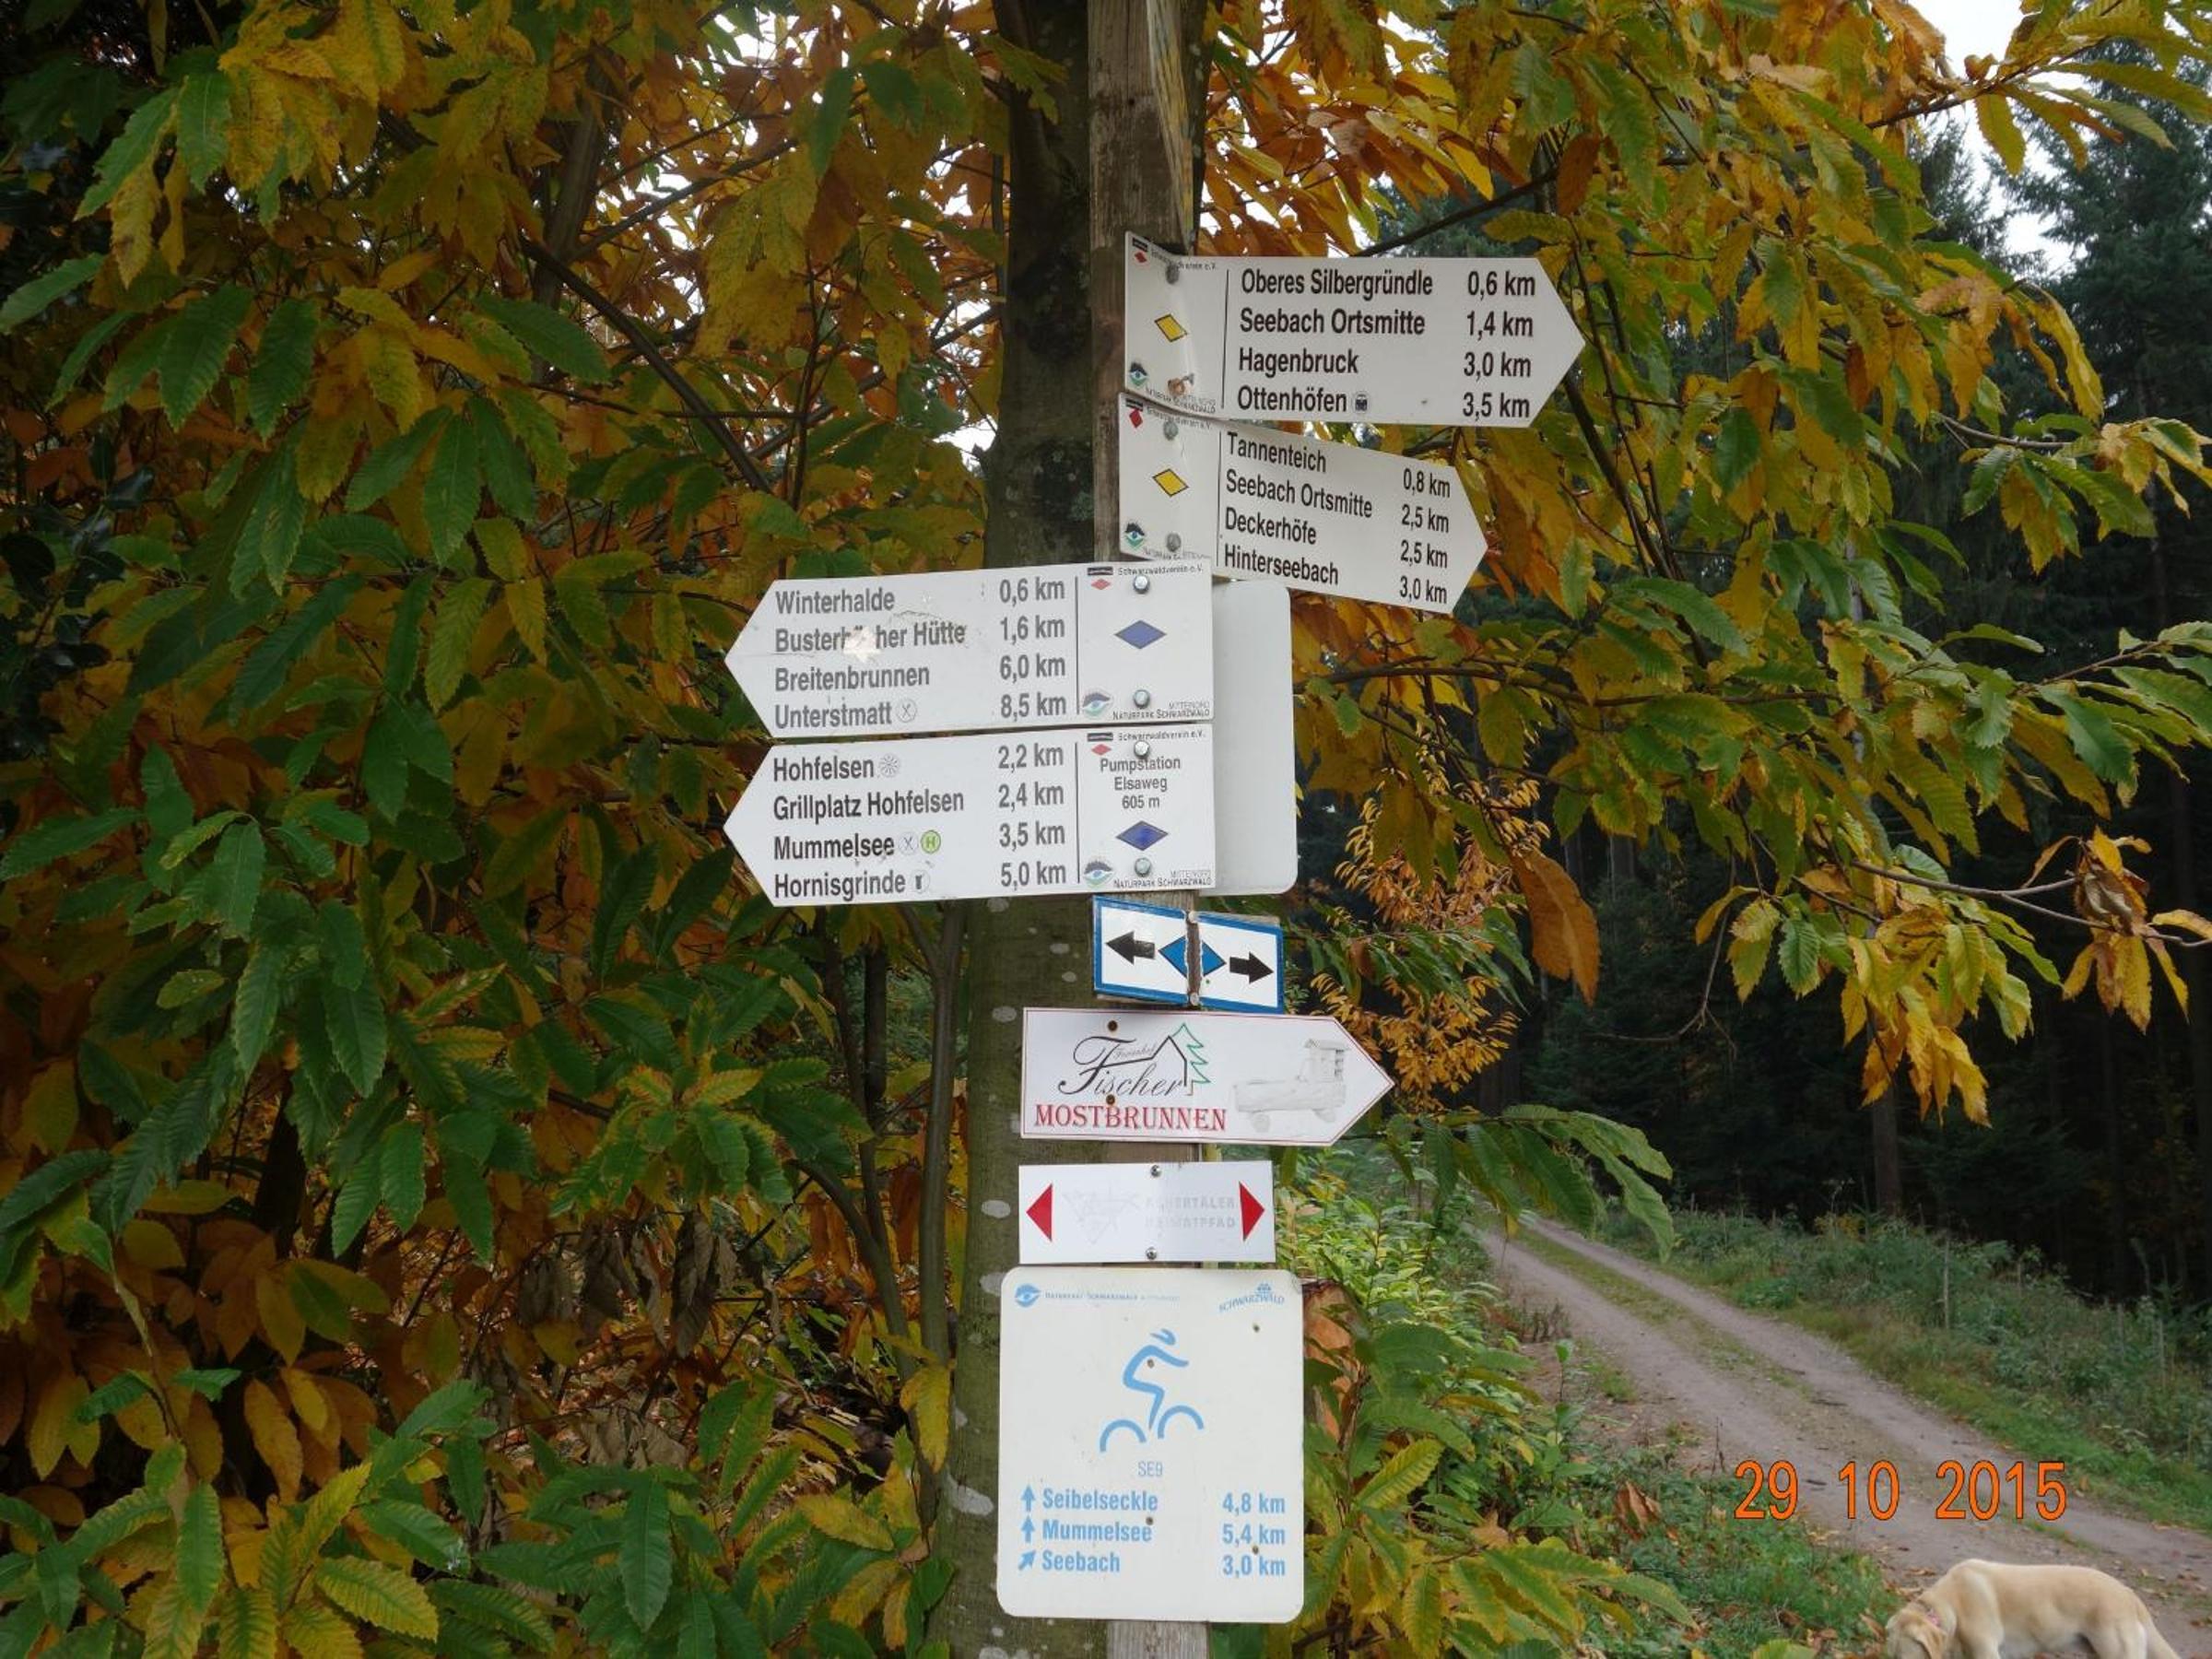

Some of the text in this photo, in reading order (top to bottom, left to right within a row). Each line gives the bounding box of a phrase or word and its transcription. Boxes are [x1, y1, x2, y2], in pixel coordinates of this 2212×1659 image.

[1241, 269, 1535, 301] Oberes Silbergründle 0,6 km
[1240, 309, 1534, 341] Seebach Ortsmitte 1,4 km
[1239, 347, 1532, 382] Hagenbruck 3,0 km
[1238, 384, 1347, 413] Ottenhöfen
[1463, 392, 1493, 421] 3,5
[1500, 393, 1530, 418] km
[1227, 431, 1451, 499] Tannenteich 0,8 km
[1226, 468, 1450, 534] Seebach Ortsmitte 2,5 km
[1225, 507, 1448, 570] Deckerhöfe 2,5 km
[1224, 545, 1339, 585] Hinterseebach
[1400, 575, 1421, 600] 3,0
[1426, 580, 1448, 605] km
[775, 578, 1065, 615] Winterhalde 0,6 km
[913, 621, 966, 647] Hütte
[1000, 618, 1030, 643] 1,6
[1035, 617, 1065, 640] km
[775, 654, 1066, 691] Breitenbrunnen 6,0 km
[775, 693, 1066, 729] Unterstmatt 8,5 km
[773, 744, 1065, 782] Hohfelsen 2,2 km
[1100, 756, 1181, 774] Pumpstation
[773, 782, 1065, 822] Grillplatz Hohfelsen 2,4 km
[1113, 776, 1168, 792] Elsaweg
[1122, 794, 1159, 808] 605 m
[773, 833, 895, 860] Mummelsee
[999, 823, 1030, 851] 3,5
[1036, 821, 1065, 846] km
[774, 861, 1066, 901] Hornisgrinde 5,0 km
[1058, 1036, 1183, 1097] Fischer
[1034, 1103, 1227, 1132] MOSTBRUNNEN
[1042, 1488, 1286, 1516] Seibelseckle 4,8 km
[1042, 1519, 1286, 1547] Mummelsee 5,4 km
[1042, 1550, 1286, 1579] Seebach 3,0 km
